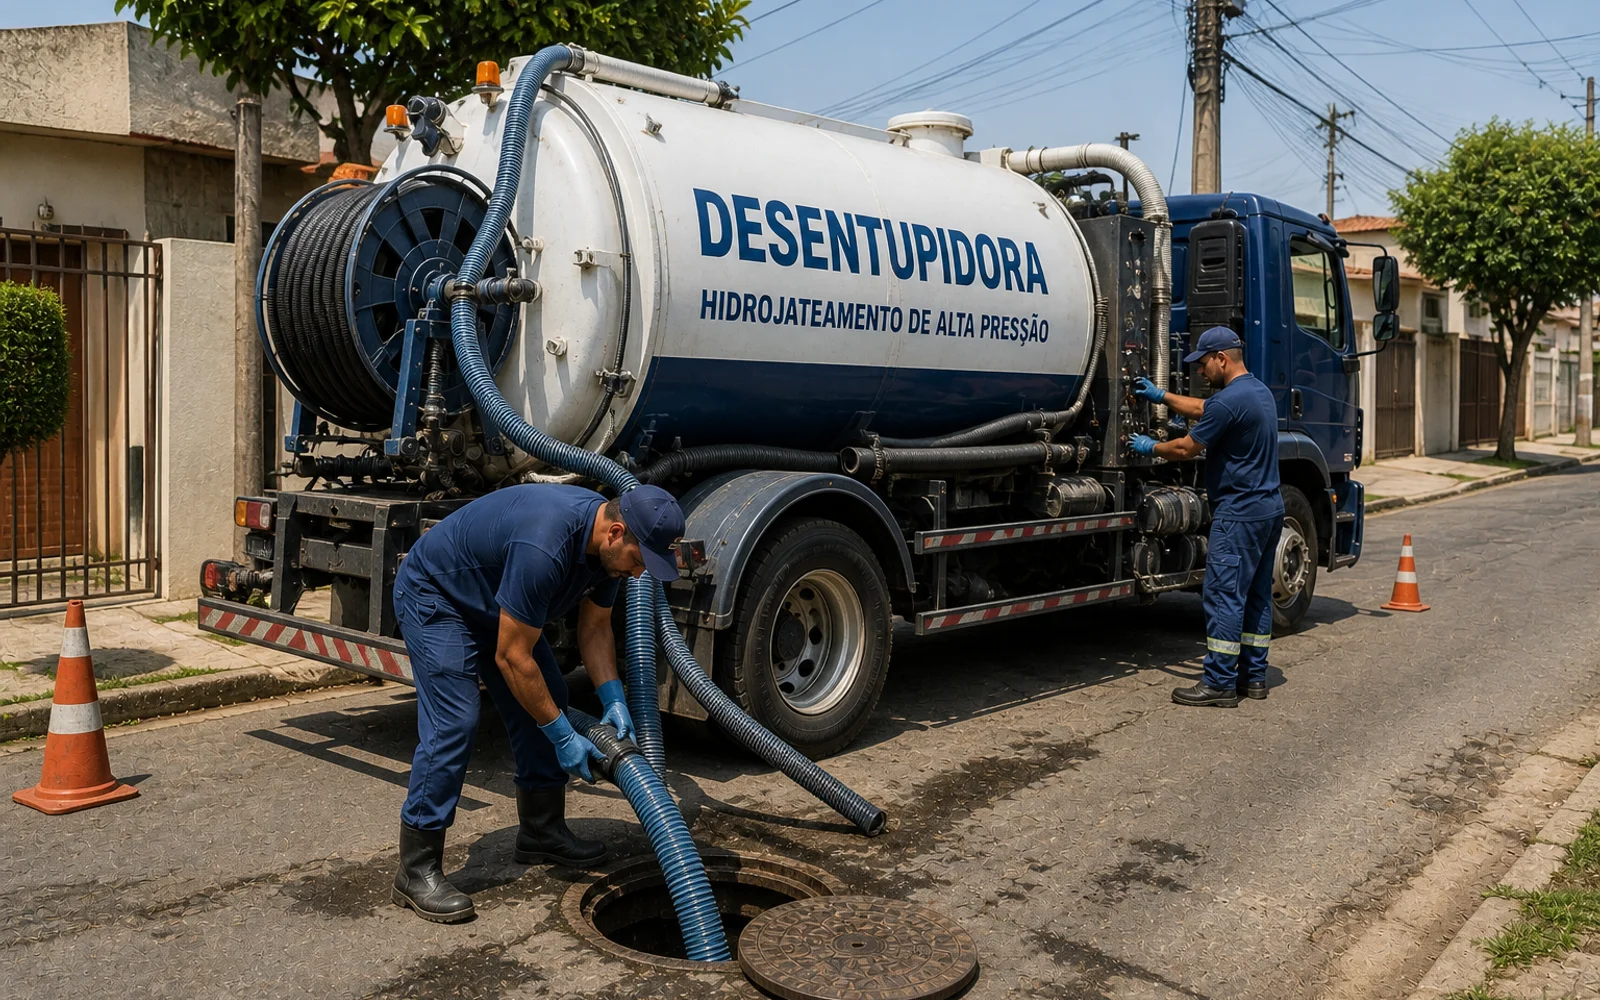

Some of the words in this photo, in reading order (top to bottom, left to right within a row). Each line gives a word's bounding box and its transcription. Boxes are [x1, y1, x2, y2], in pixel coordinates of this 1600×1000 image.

[692, 187, 1049, 296] DESENTUPIDORA
[699, 288, 904, 334] HIDROJATEAMENTO
[907, 308, 932, 335] DE
[935, 310, 975, 339] ALTA
